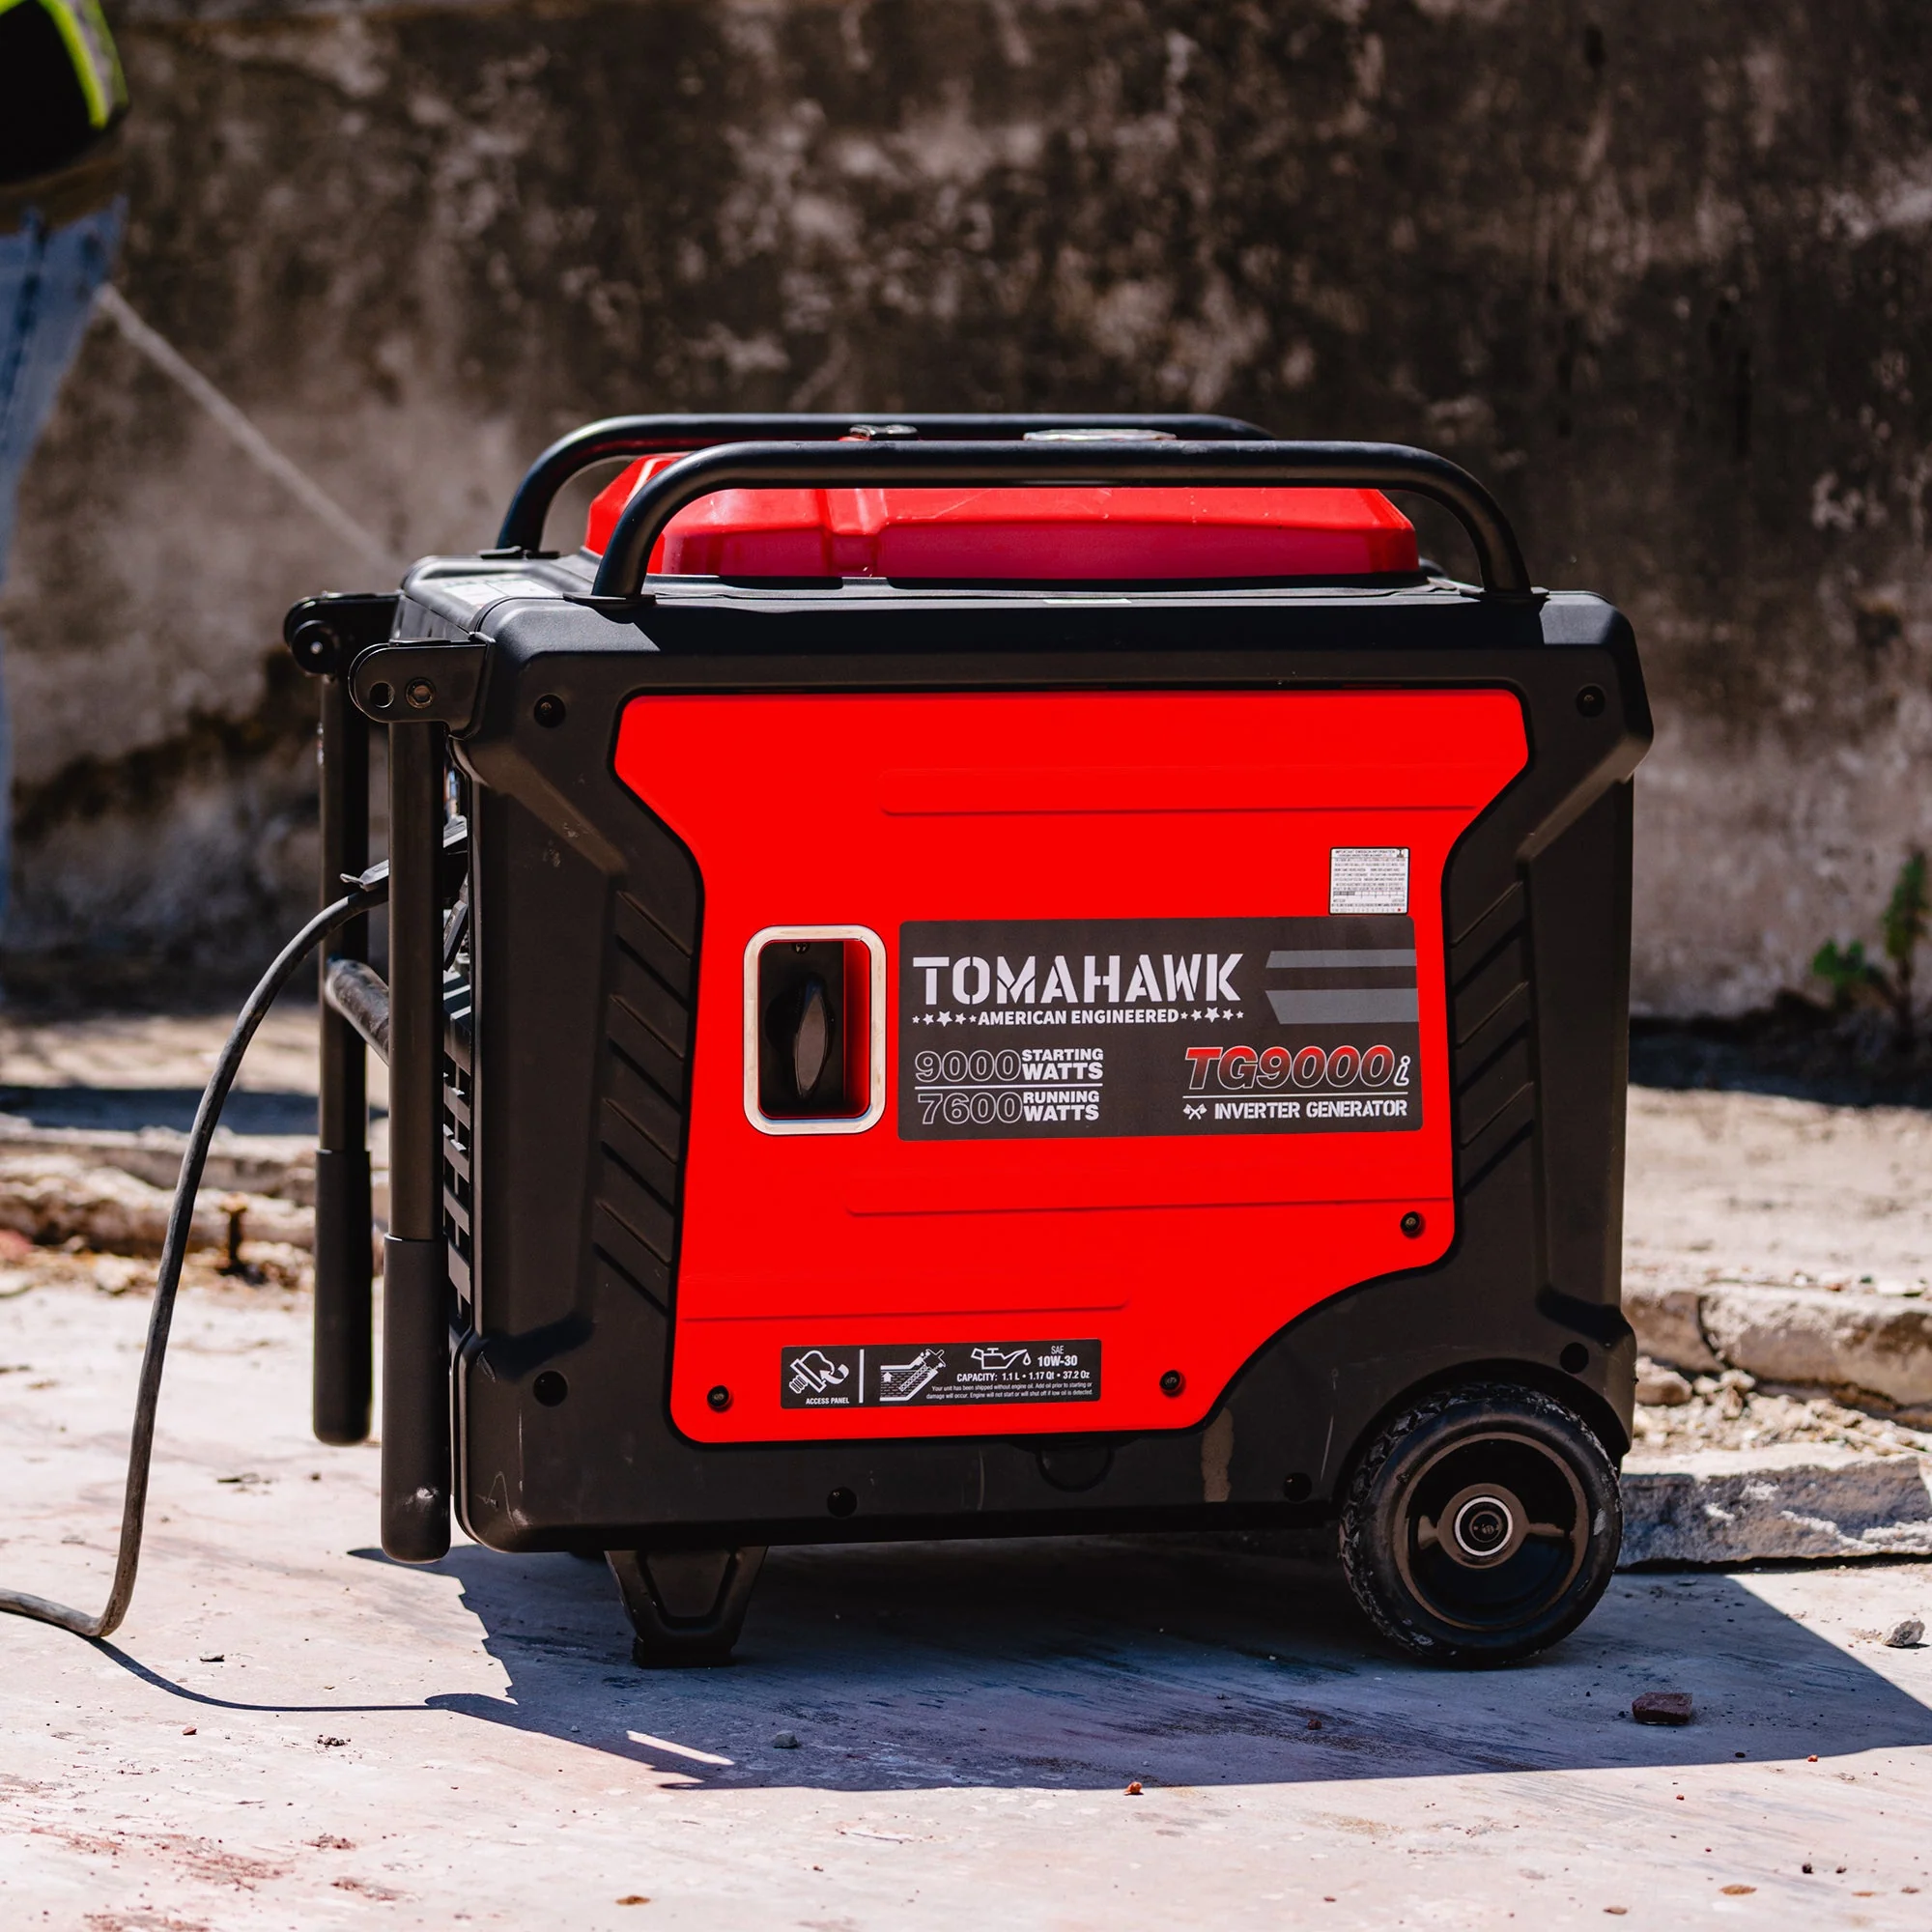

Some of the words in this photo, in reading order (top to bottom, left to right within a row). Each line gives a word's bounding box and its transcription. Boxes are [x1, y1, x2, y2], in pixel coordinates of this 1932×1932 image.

[913, 953, 1243, 1005] TOMAHAWK
[978, 1011, 1066, 1026] AMERICAN
[1071, 1009, 1179, 1024] ENGINEERED
[1022, 1048, 1103, 1062] STARTING
[915, 1050, 1022, 1083] 9000
[1022, 1063, 1103, 1081] WATTS
[1023, 1091, 1099, 1104] RUNNING
[918, 1092, 1022, 1125] 7600
[1024, 1105, 1099, 1121] WATTS
[1215, 1102, 1300, 1119] INVERTER
[1306, 1100, 1407, 1118] GENERATOR
[1051, 1345, 1064, 1354] SAE
[1037, 1355, 1078, 1367] 10W-30
[957, 1373, 997, 1382] CAPACITY:
[1029, 1371, 1044, 1380] 1.17
[1063, 1370, 1079, 1379] 37.2
[1081, 1370, 1090, 1379] Oz
